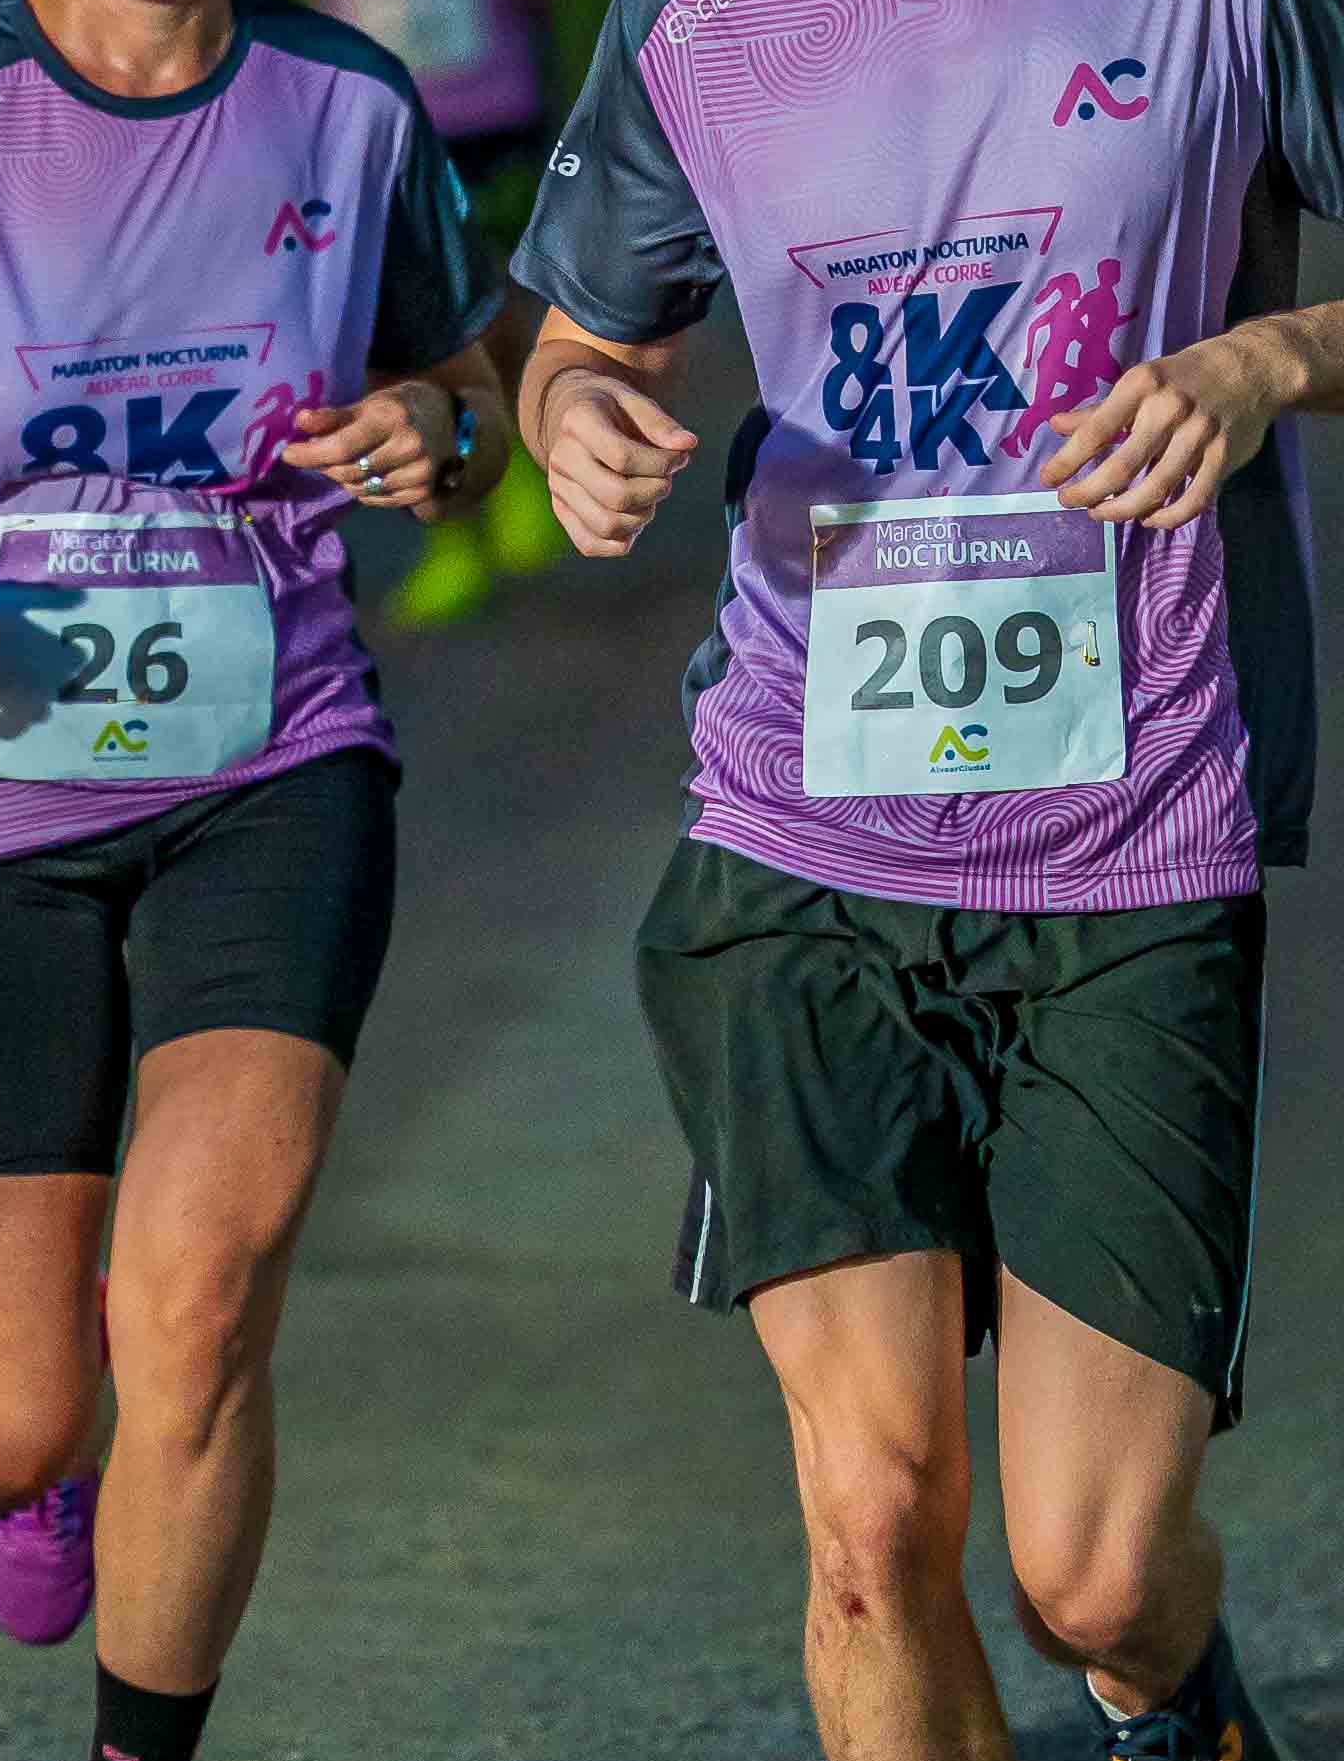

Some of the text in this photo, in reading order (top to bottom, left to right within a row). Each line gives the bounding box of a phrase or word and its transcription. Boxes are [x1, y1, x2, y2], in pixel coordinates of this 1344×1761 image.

[826, 232, 1030, 279] MARATON NOCTURNA
[867, 262, 993, 296] ALVEAR CORRE
[51, 343, 249, 380] MARATON NOCTURNA
[821, 281, 1031, 432] 8K
[849, 376, 993, 476] 4K
[875, 517, 962, 543] Maratón
[47, 550, 202, 575] NOCTURNA
[875, 539, 1034, 571] NOCTURNA
[57, 622, 189, 704] 26
[850, 610, 1063, 712] 209
